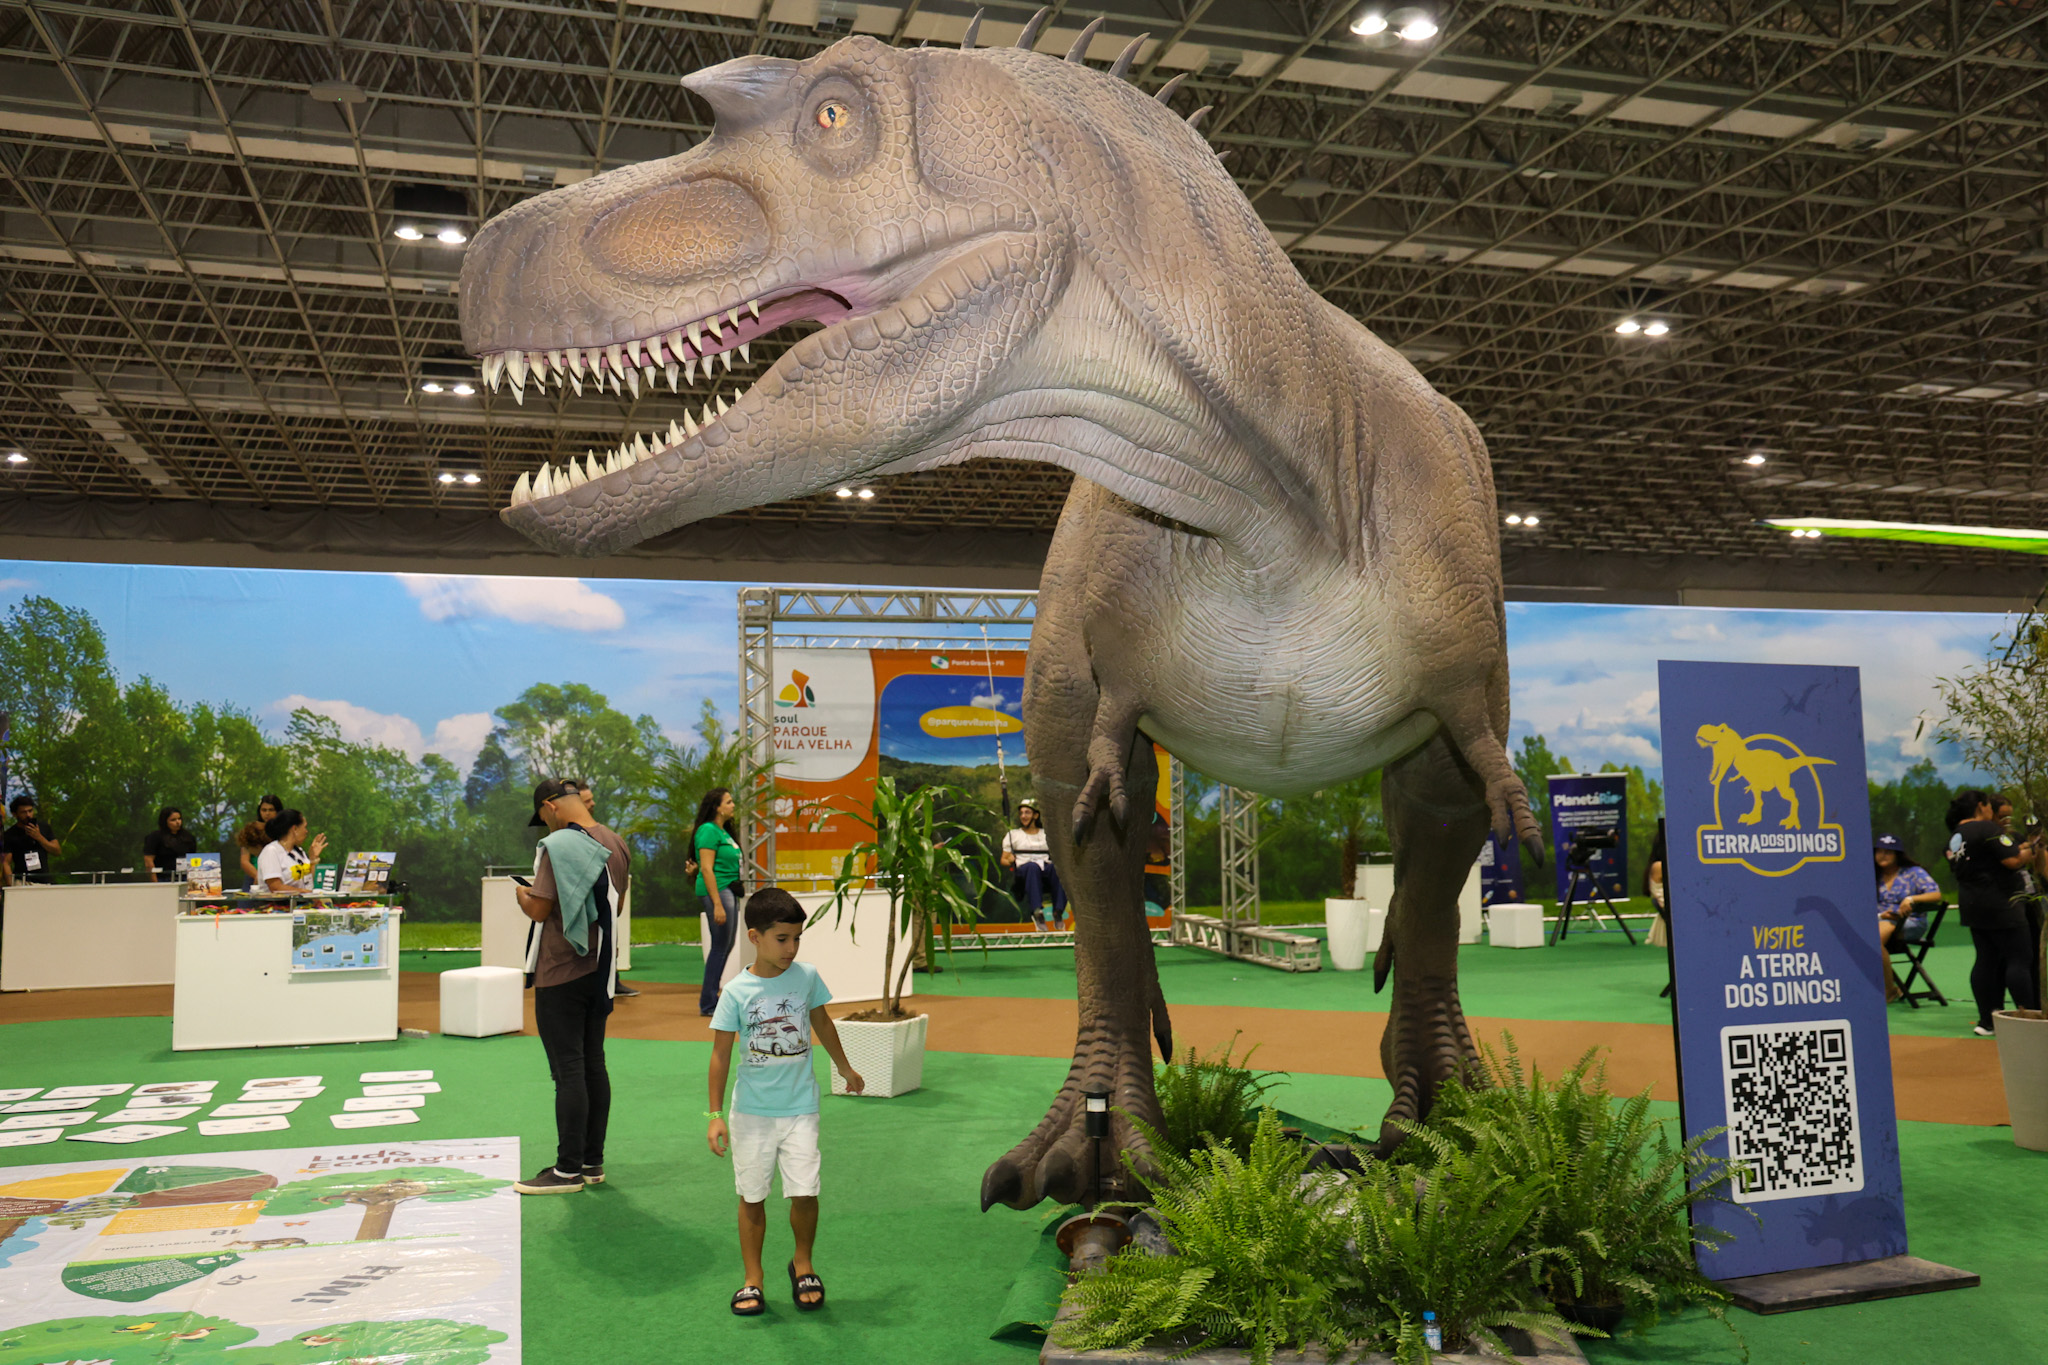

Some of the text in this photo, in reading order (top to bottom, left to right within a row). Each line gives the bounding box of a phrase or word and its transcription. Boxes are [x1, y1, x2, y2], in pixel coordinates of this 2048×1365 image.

[773, 714, 798, 723] soul
[773, 726, 827, 737] PARQUE
[773, 740, 853, 750] VILA VELHA
[1704, 833, 1838, 854] TERRA DOS DINOS
[1752, 925, 1805, 950] VISITE
[1740, 952, 1824, 979] A TERRA
[1724, 979, 1841, 1008] DOS DINOS!
[312, 1149, 411, 1162] Ludo
[228, 1202, 260, 1211] 17
[210, 1228, 242, 1236] 18
[195, 1255, 233, 1265] 19
[217, 1275, 257, 1286] 20
[290, 1265, 404, 1304] FIM!
[798, 1277, 821, 1289] FILA
[736, 1287, 761, 1297] FILA
